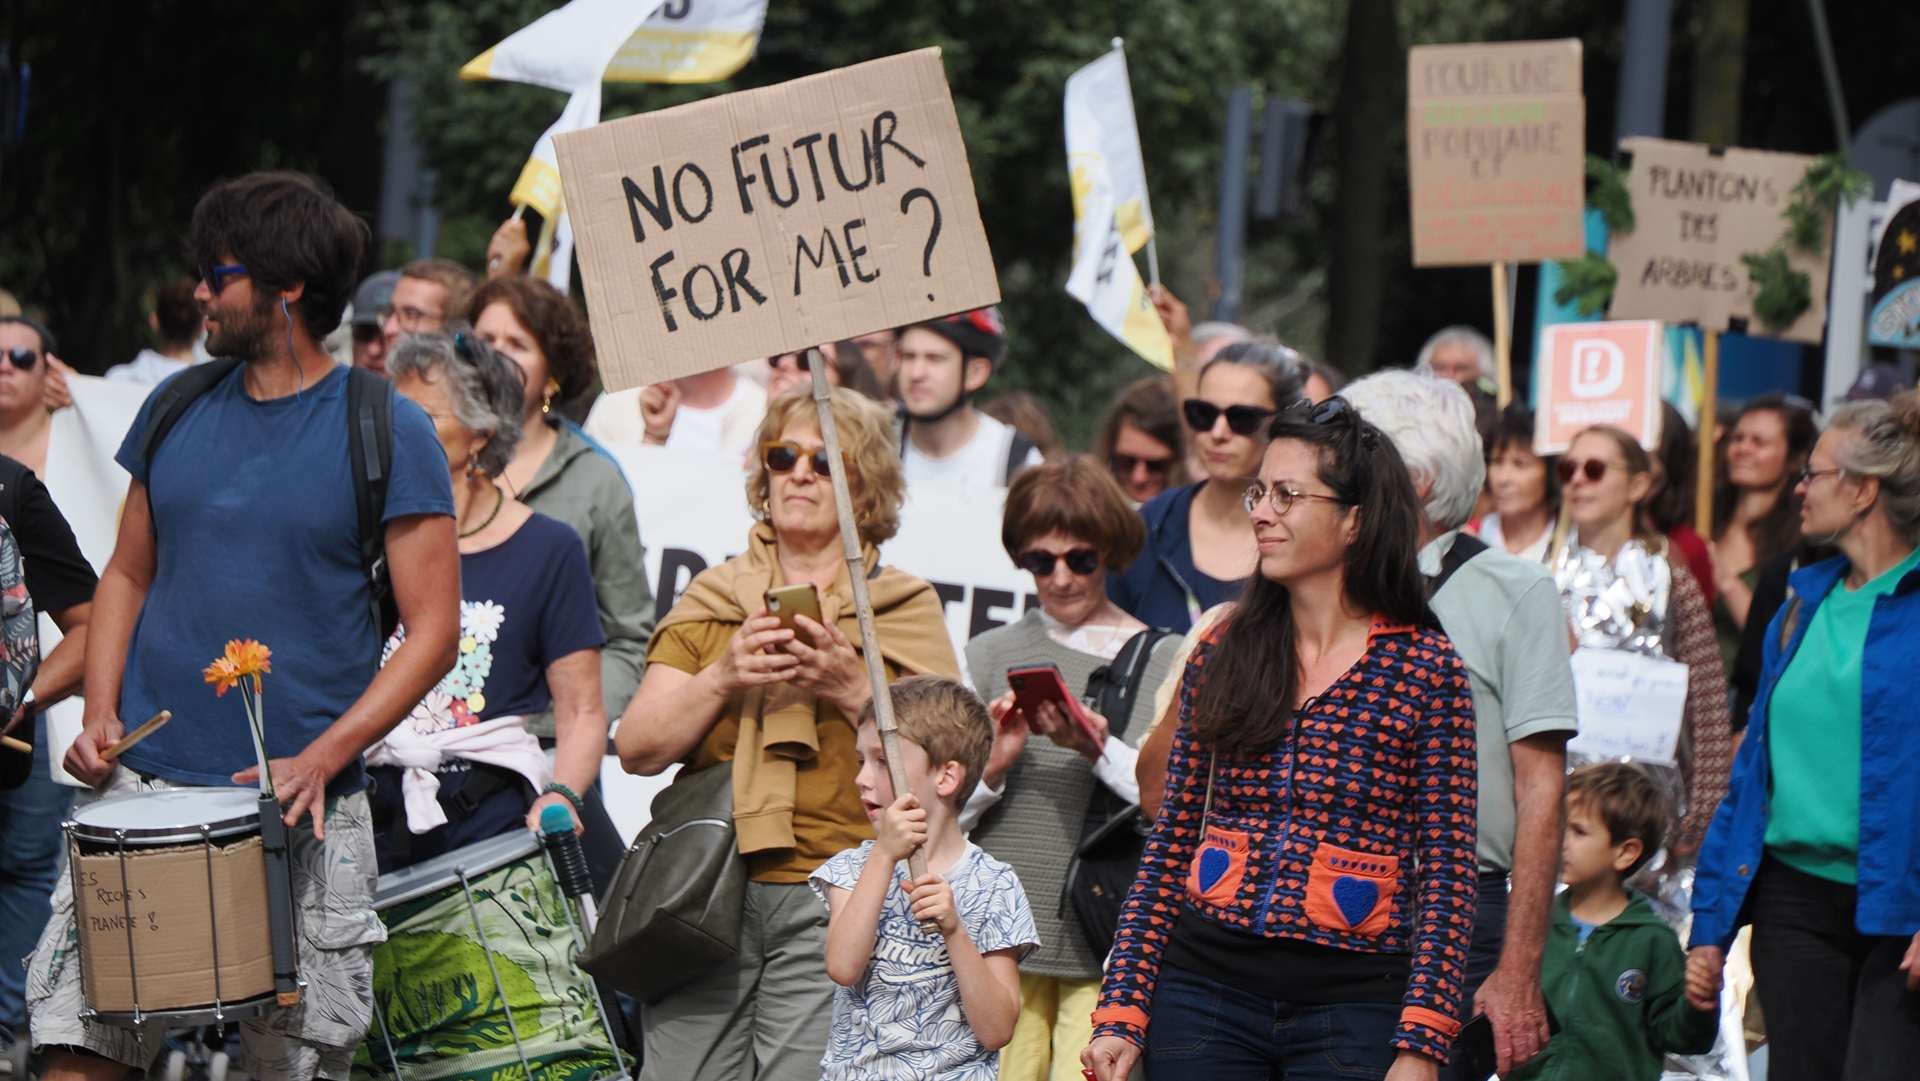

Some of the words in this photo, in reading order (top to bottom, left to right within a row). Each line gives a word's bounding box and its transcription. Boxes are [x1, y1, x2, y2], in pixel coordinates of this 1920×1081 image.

[621, 162, 713, 243] NO
[730, 110, 926, 214] FUTUR
[1648, 164, 1780, 206] PLANTONS
[649, 250, 768, 333] FOR
[793, 218, 881, 297] ME
[900, 187, 943, 302] ?
[1640, 255, 1739, 293] ARBRES
